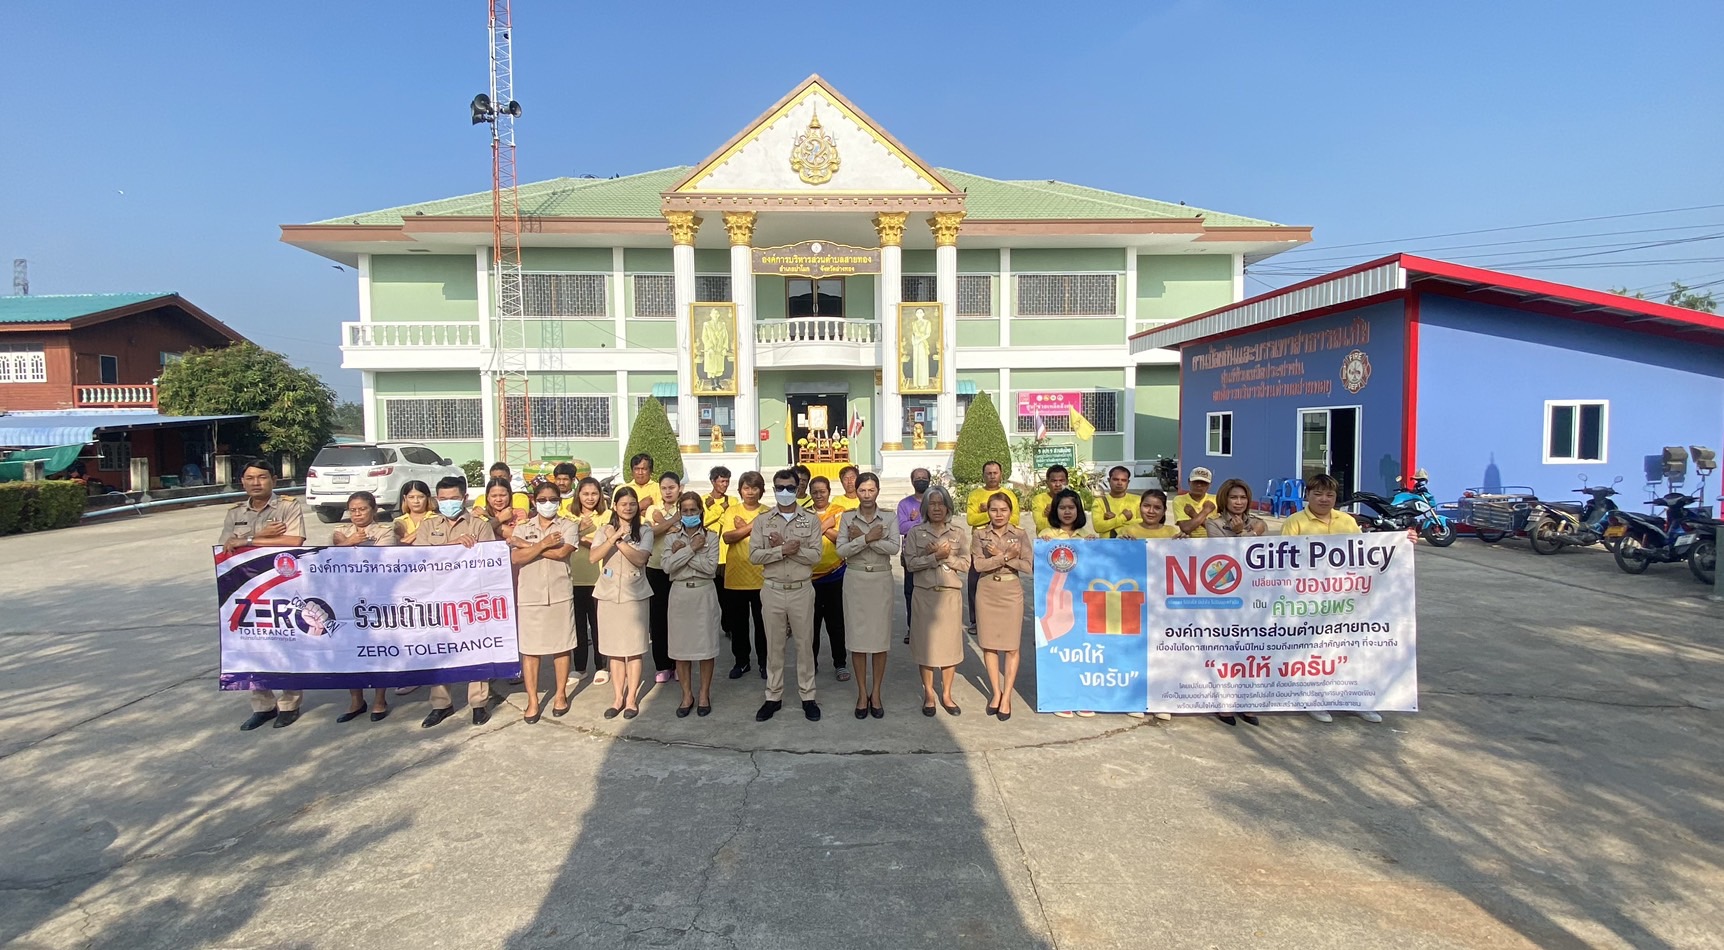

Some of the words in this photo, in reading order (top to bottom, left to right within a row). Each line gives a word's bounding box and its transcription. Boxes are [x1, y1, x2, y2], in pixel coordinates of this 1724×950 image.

[762, 254, 872, 264] องค์การบริหารส่วนตำบลสายทอง
[1348, 352, 1363, 361] FIRE
[309, 558, 502, 574] องค์การบริหารส่วนตำบลสายทอง
[1166, 554, 1243, 596] NO
[1246, 541, 1300, 569] Gift
[1309, 539, 1396, 572] Policy
[1252, 576, 1292, 587] เปลี่ยนจาก
[1295, 572, 1372, 594] ของขวัญ
[354, 594, 508, 632] ร่วมต้านทุจริต
[1252, 599, 1267, 609] เป็น
[1272, 594, 1355, 616] คำอวยพร
[239, 628, 296, 637] TOLERANCE
[1165, 622, 1390, 638] องค์การบริหารส่วนตำบลสายทอง
[356, 645, 400, 658] ZERO
[404, 636, 504, 656] TOLERANCE
[1362, 636, 1398, 648] ที่จะมาถึง
[1049, 642, 1105, 664] “งดให้
[1079, 667, 1139, 687] งดรับ”
[1204, 655, 1272, 679] “งดให้
[1278, 655, 1348, 678] งดรับ”
